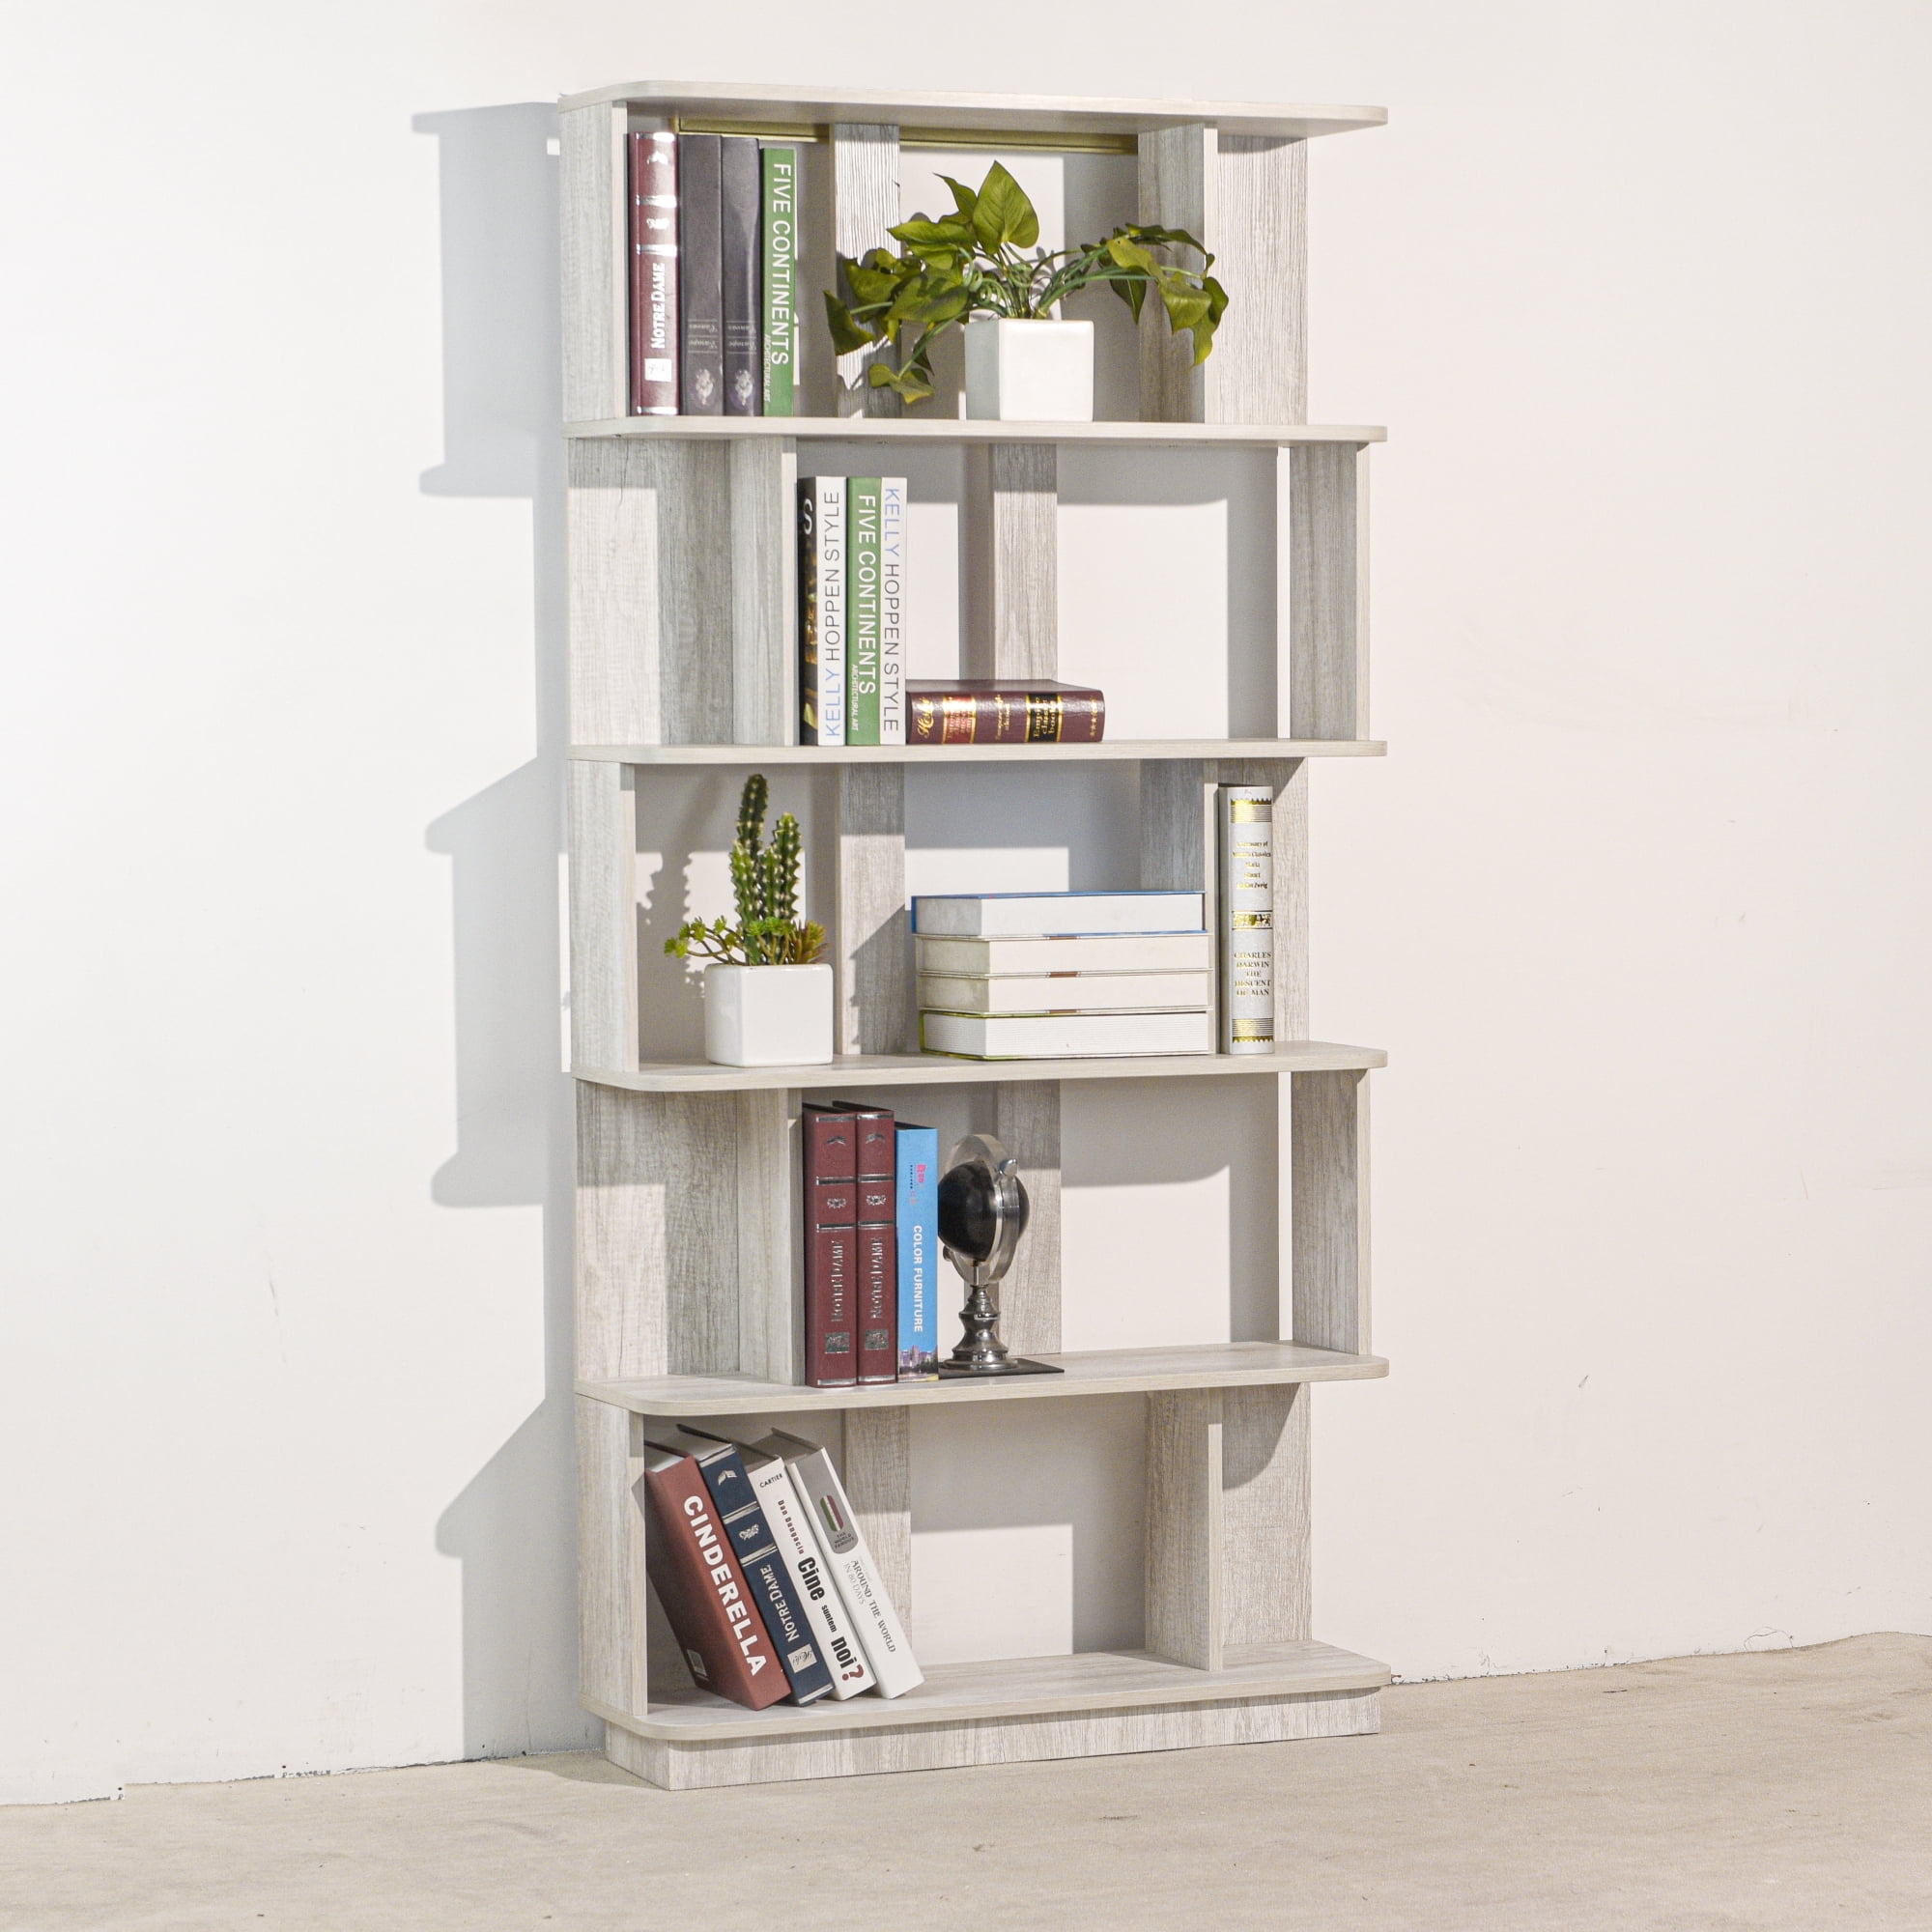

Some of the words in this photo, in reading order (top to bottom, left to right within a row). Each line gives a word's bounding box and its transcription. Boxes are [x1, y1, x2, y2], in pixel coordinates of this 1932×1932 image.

[772, 162, 792, 213] FIVE
[650, 262, 668, 302] DAME
[770, 219, 792, 365] CONTINENTS
[650, 304, 668, 349] NOTRE
[762, 334, 772, 386] ARCHITECTURAL
[762, 387, 772, 403] ART
[824, 492, 840, 561] STYLE
[858, 494, 876, 544] FIVE
[884, 488, 900, 557] KELLY
[825, 569, 840, 661] HOPPEN
[858, 551, 876, 695] CONTINENTS
[883, 564, 900, 656] HOPPEN
[825, 668, 840, 737] KELLY
[883, 662, 899, 732] STYLE
[912, 1225, 923, 1264] COLOR
[912, 1267, 924, 1332] FURNITURE
[759, 1472, 783, 1489] CARTIER
[777, 1498, 788, 1516] Dan
[683, 1494, 767, 1677] CINDERELLA
[759, 1564, 784, 1603] DAME
[850, 1559, 872, 1598] AROUND
[868, 1600, 882, 1618] THE
[877, 1621, 896, 1654] WORLD
[852, 1583, 867, 1605] DAYS
[775, 1599, 801, 1643] NOTRE
[797, 1556, 826, 1602] Cine
[821, 1604, 838, 1634] suntem
[831, 1635, 865, 1683] noi?
